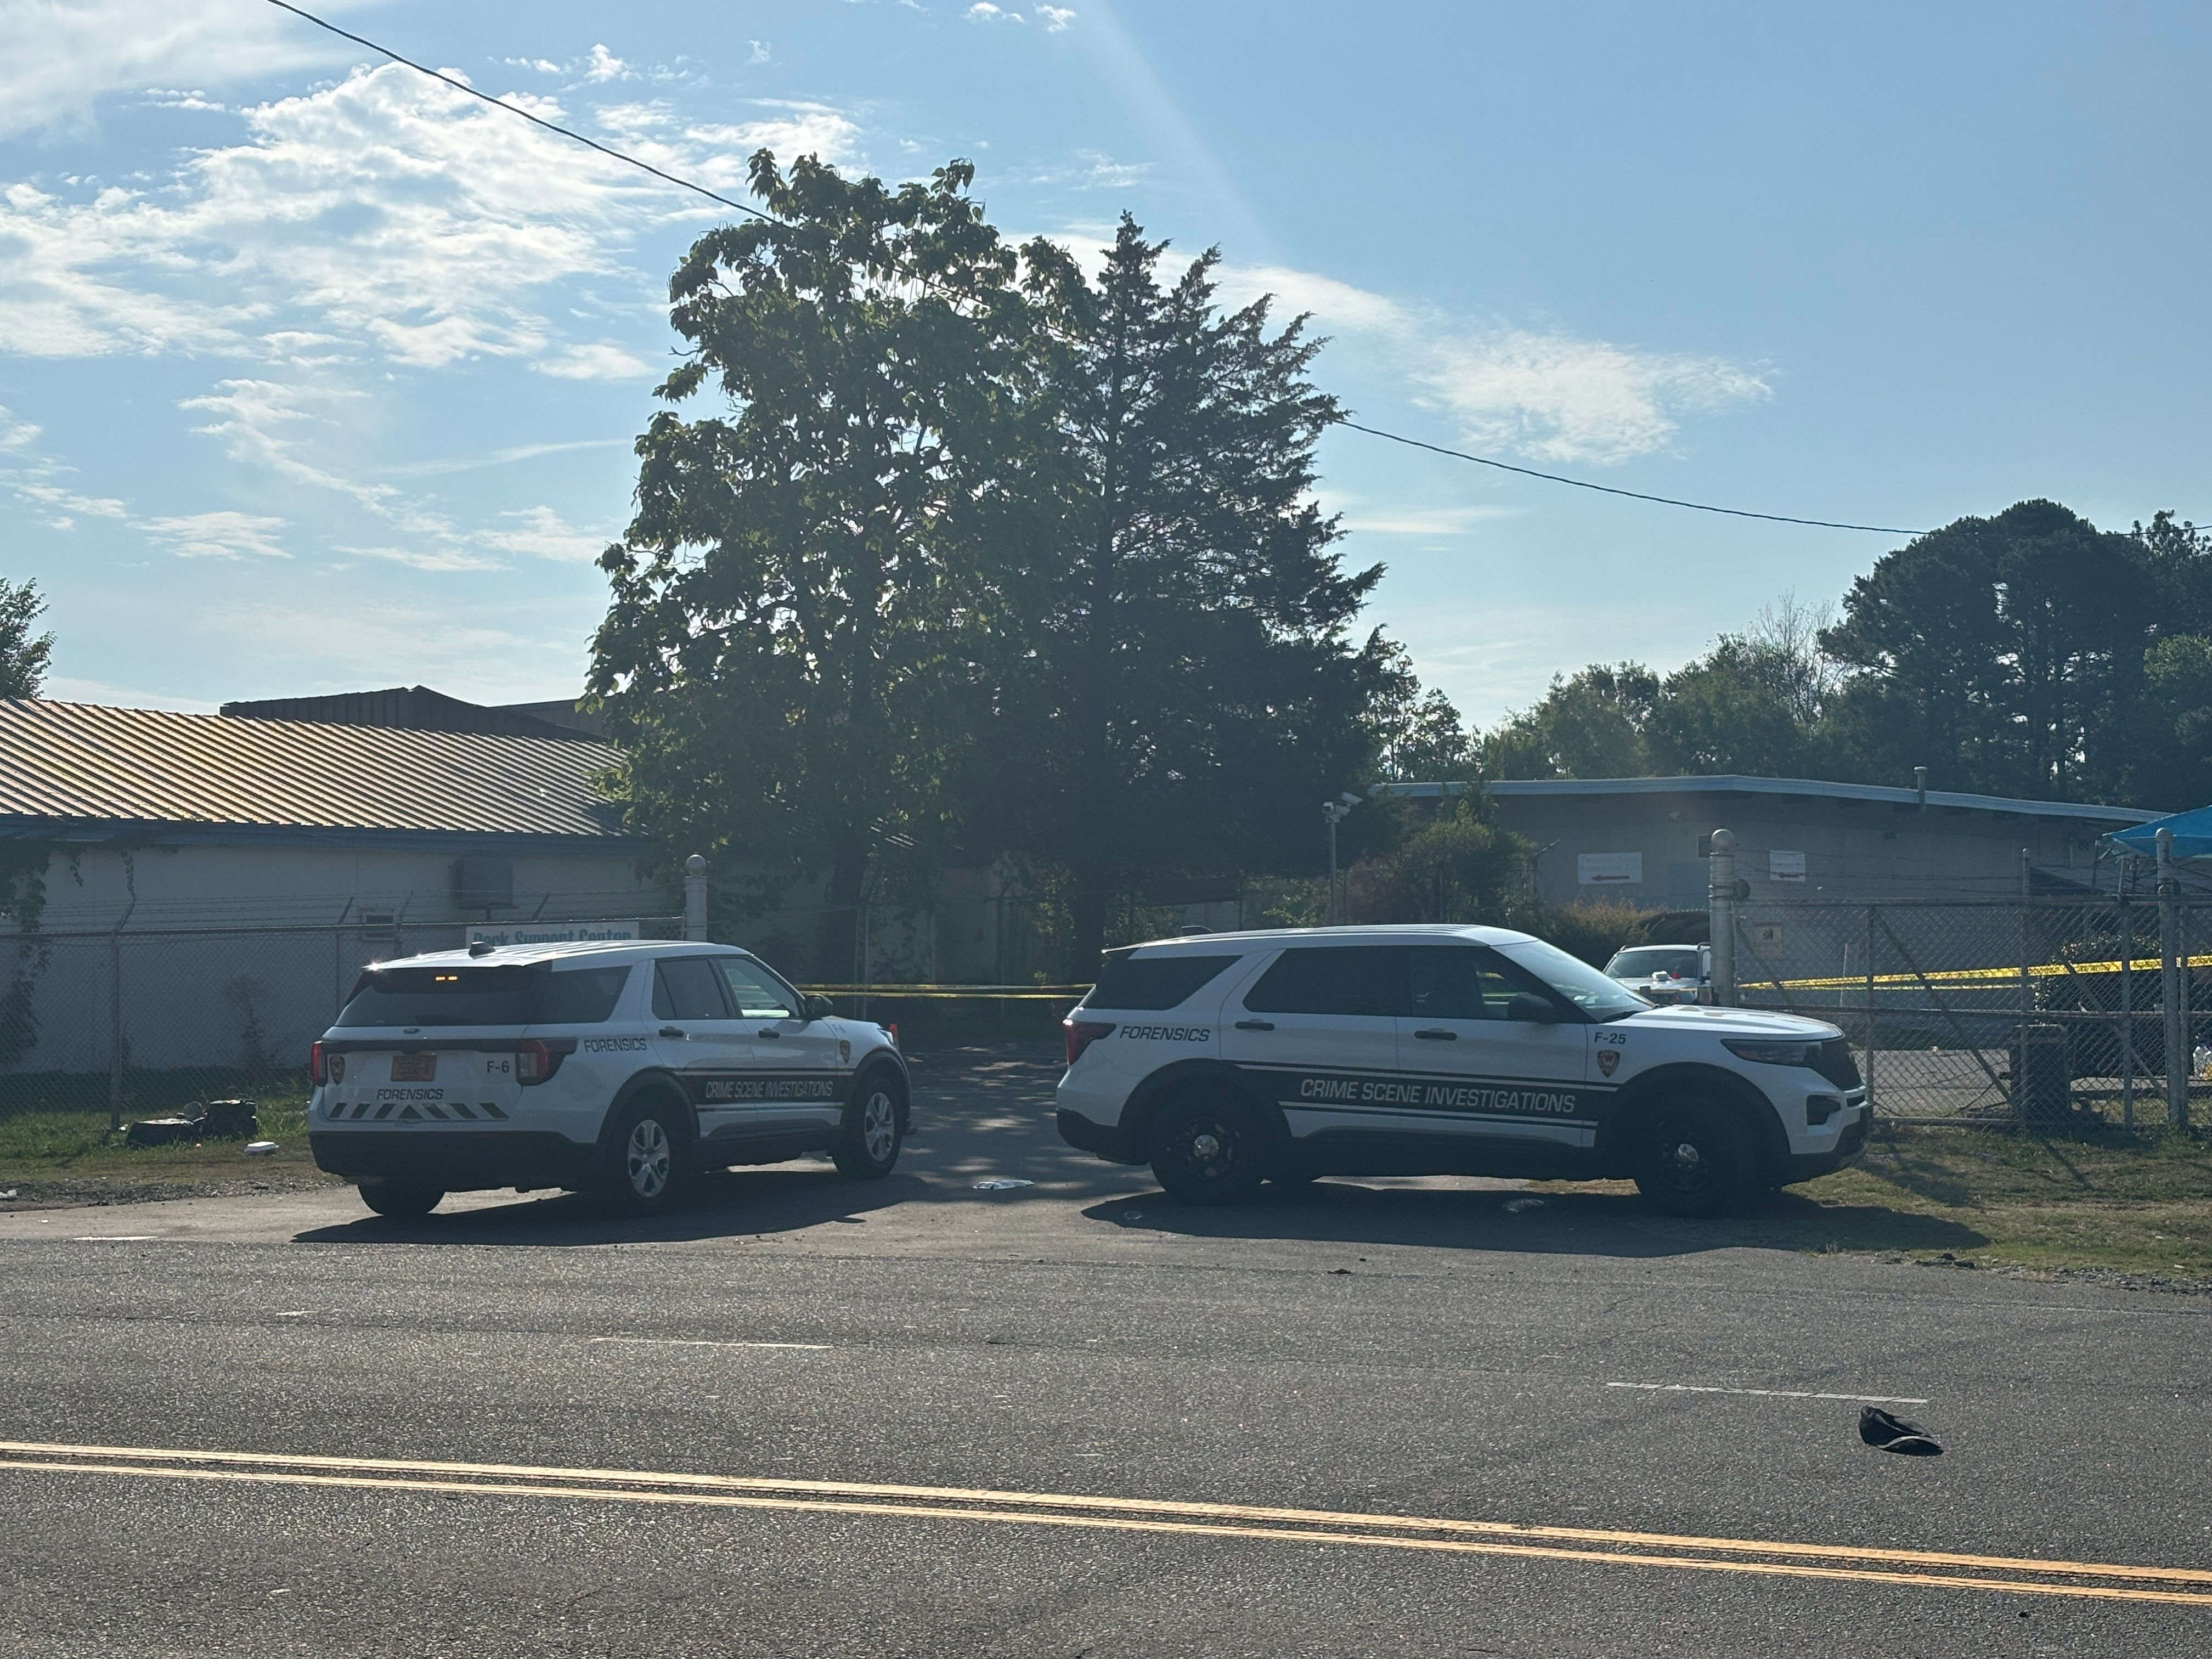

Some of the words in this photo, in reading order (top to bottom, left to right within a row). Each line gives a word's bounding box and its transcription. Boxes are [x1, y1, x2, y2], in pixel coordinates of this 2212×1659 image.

[1119, 1025, 1210, 1042] FORENSICS
[1594, 1032, 1626, 1045] F-25
[583, 1037, 647, 1053] FORENSICS
[487, 1060, 510, 1074] F-6
[377, 1088, 444, 1101] FORENSICS
[706, 1081, 734, 1098] CRIME
[734, 1081, 764, 1098] SCENE
[764, 1080, 833, 1098] INVESTIGATIONS
[1300, 1079, 1358, 1099] CRIME
[1362, 1082, 1422, 1103] SCENE
[1425, 1086, 1576, 1113] INVESTIGATIONS
